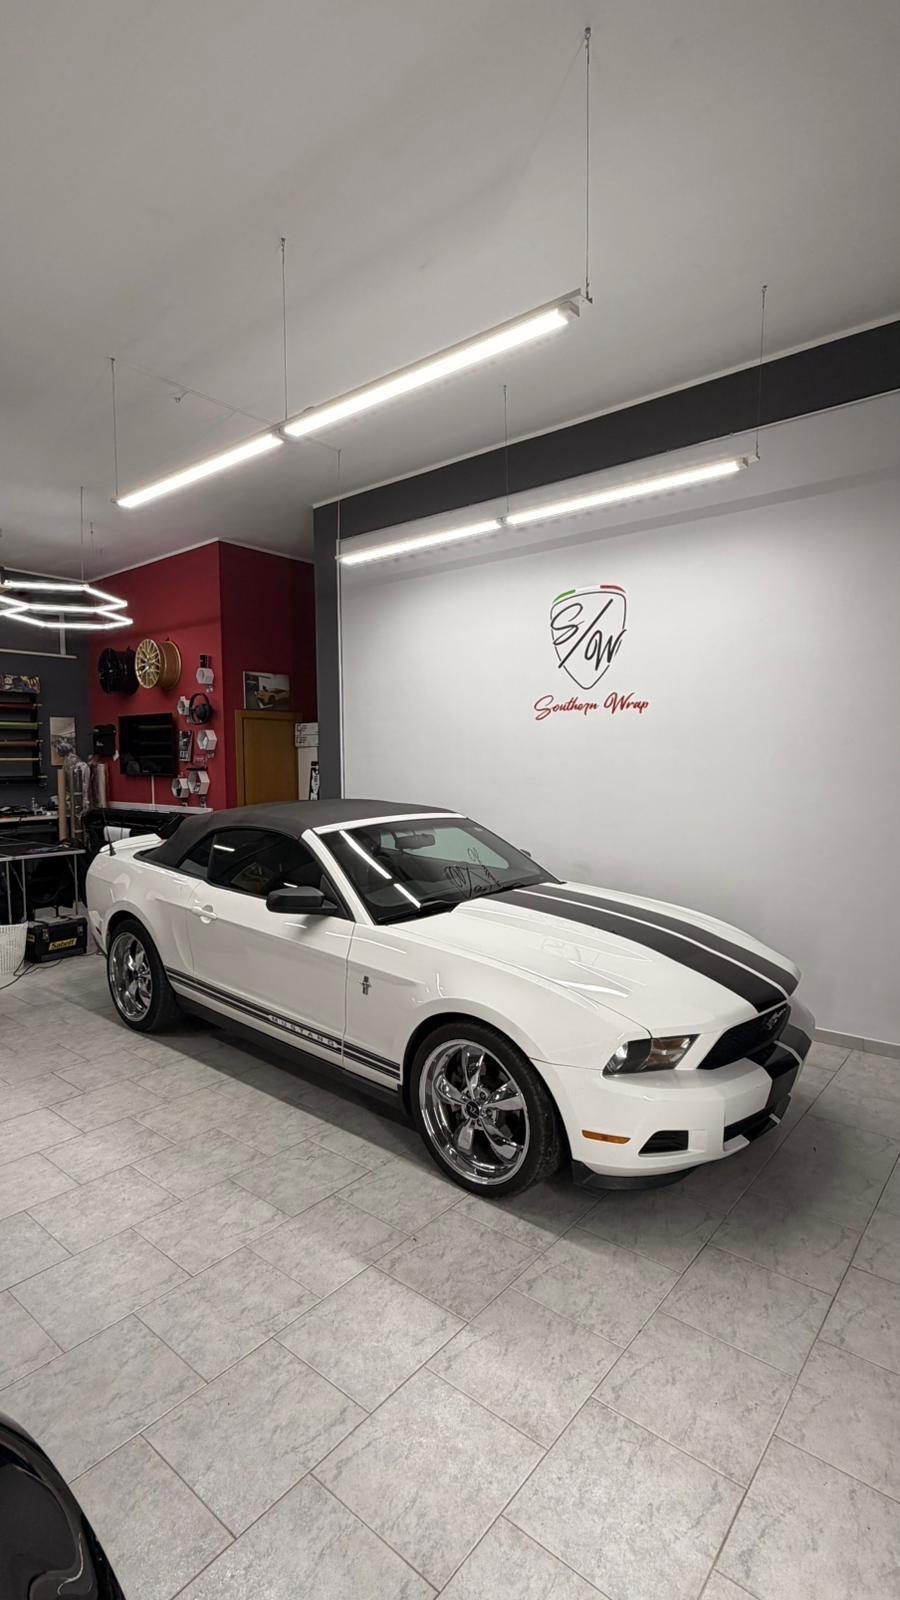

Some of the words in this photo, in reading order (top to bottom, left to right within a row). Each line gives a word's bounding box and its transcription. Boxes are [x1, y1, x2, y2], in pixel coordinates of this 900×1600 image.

[534, 694, 599, 721] Southern
[603, 691, 649, 715] Wrap
[271, 1015, 334, 1047] MUSTANG
